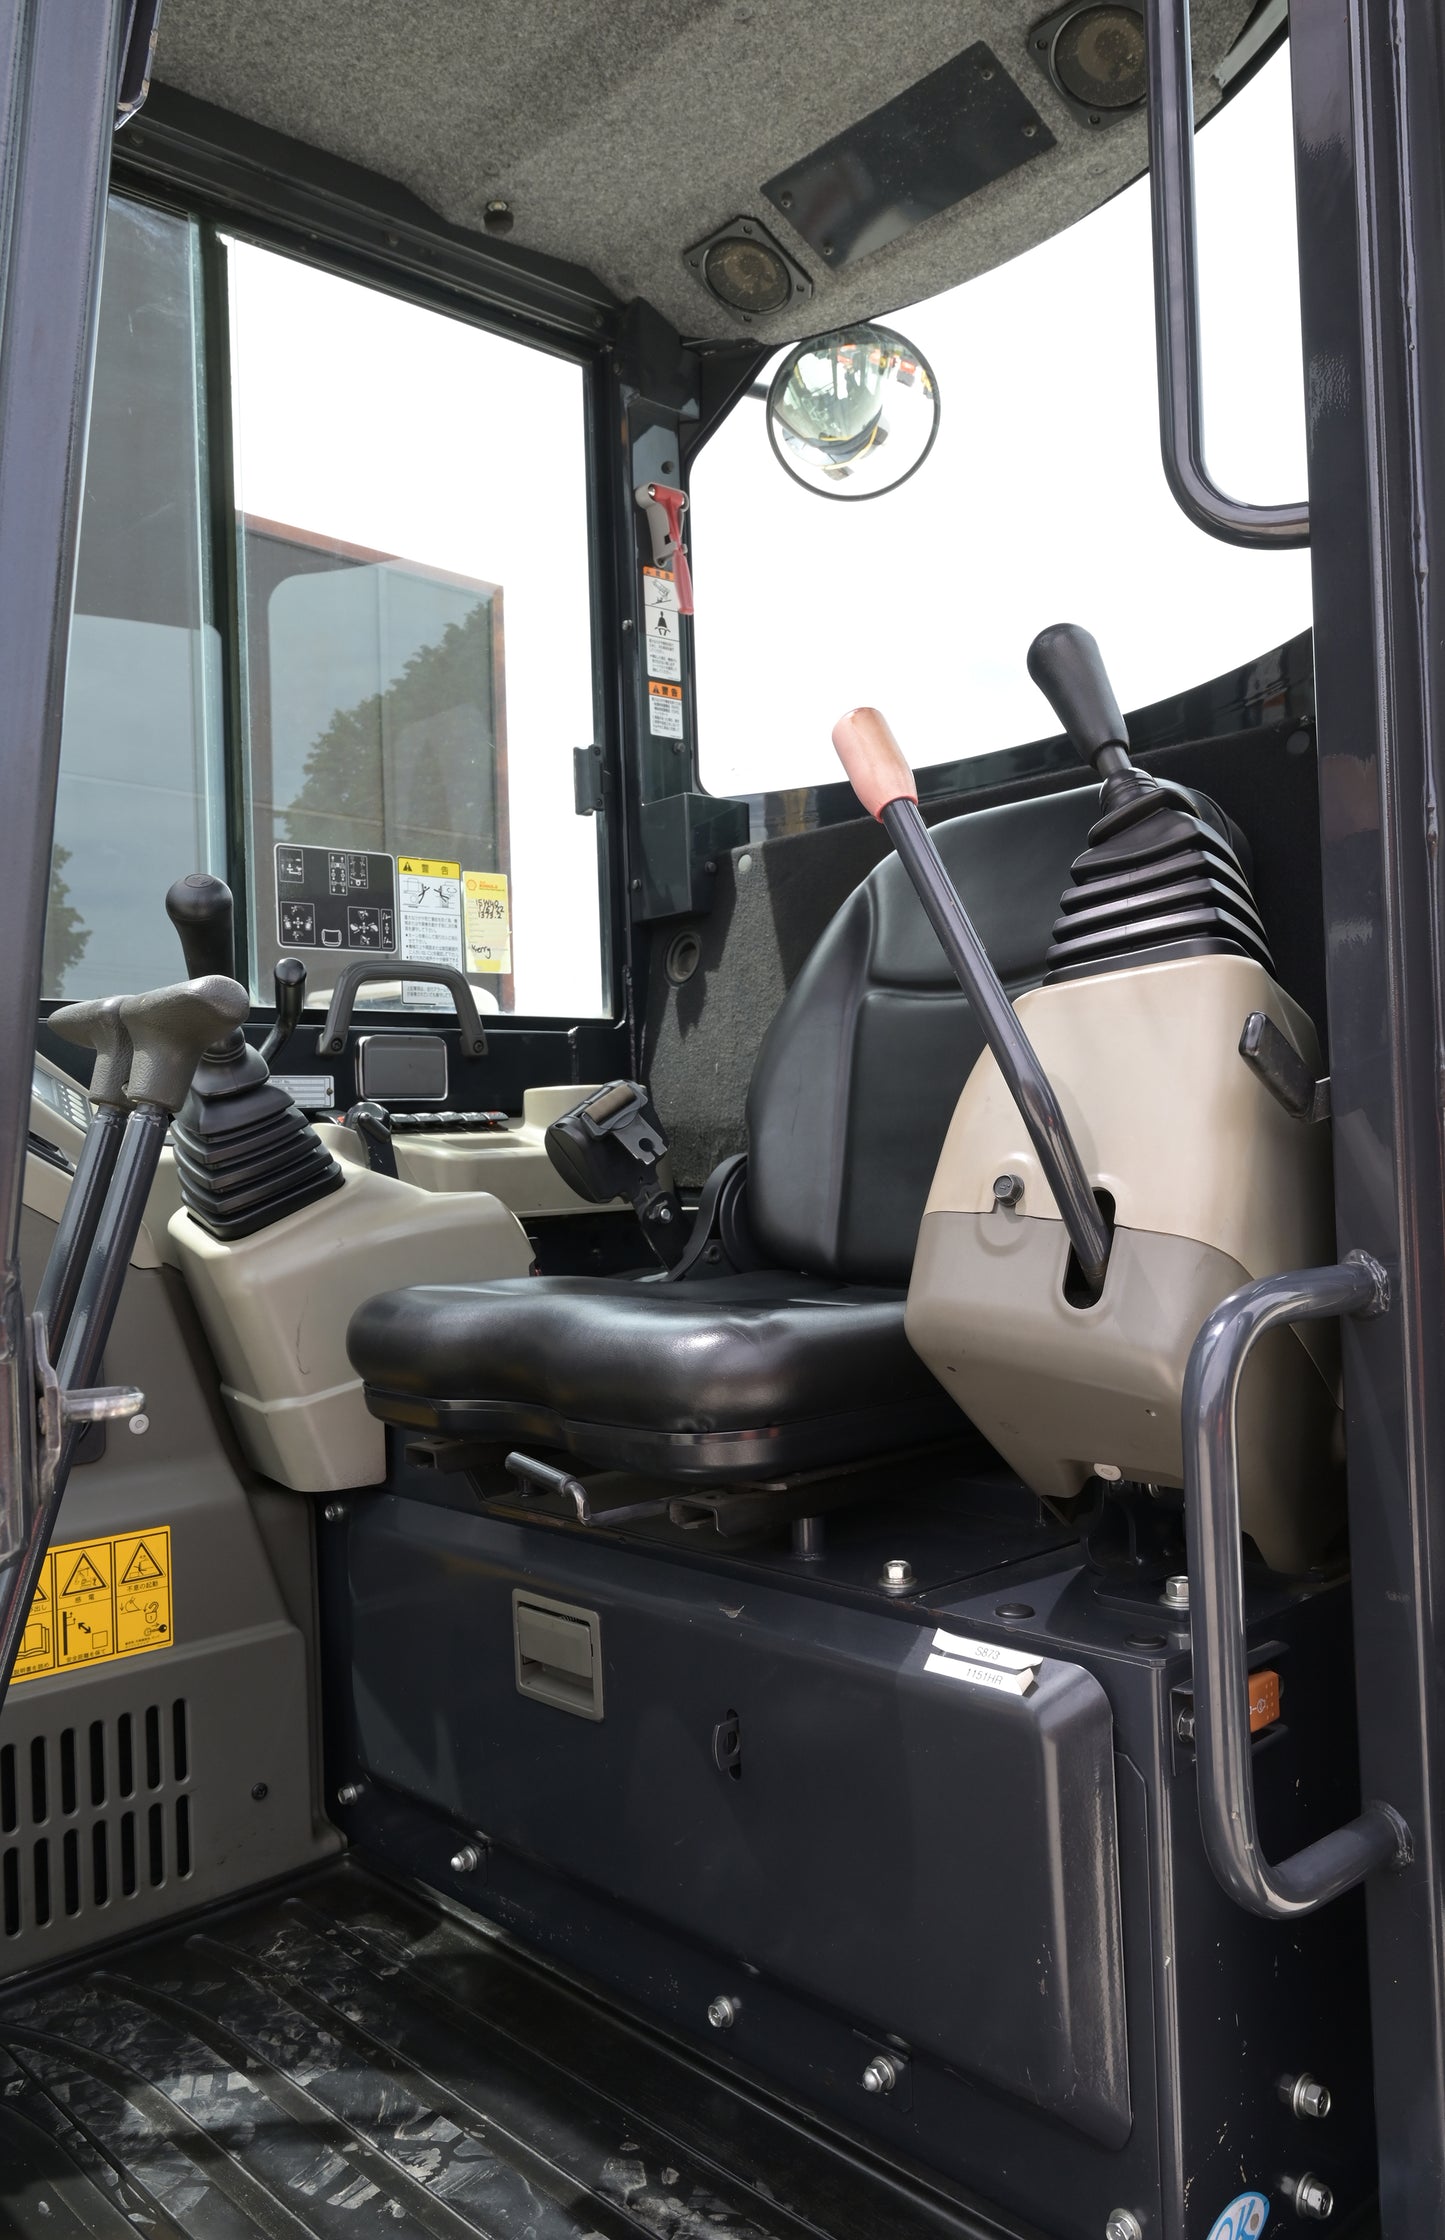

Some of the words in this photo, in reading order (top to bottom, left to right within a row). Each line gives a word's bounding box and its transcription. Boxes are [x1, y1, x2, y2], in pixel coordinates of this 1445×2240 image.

[421, 864, 449, 875] 警告
[127, 1580, 159, 1592] 不意の起動
[974, 1646, 1001, 1660] S873
[966, 1668, 1004, 1685] 1151HR
